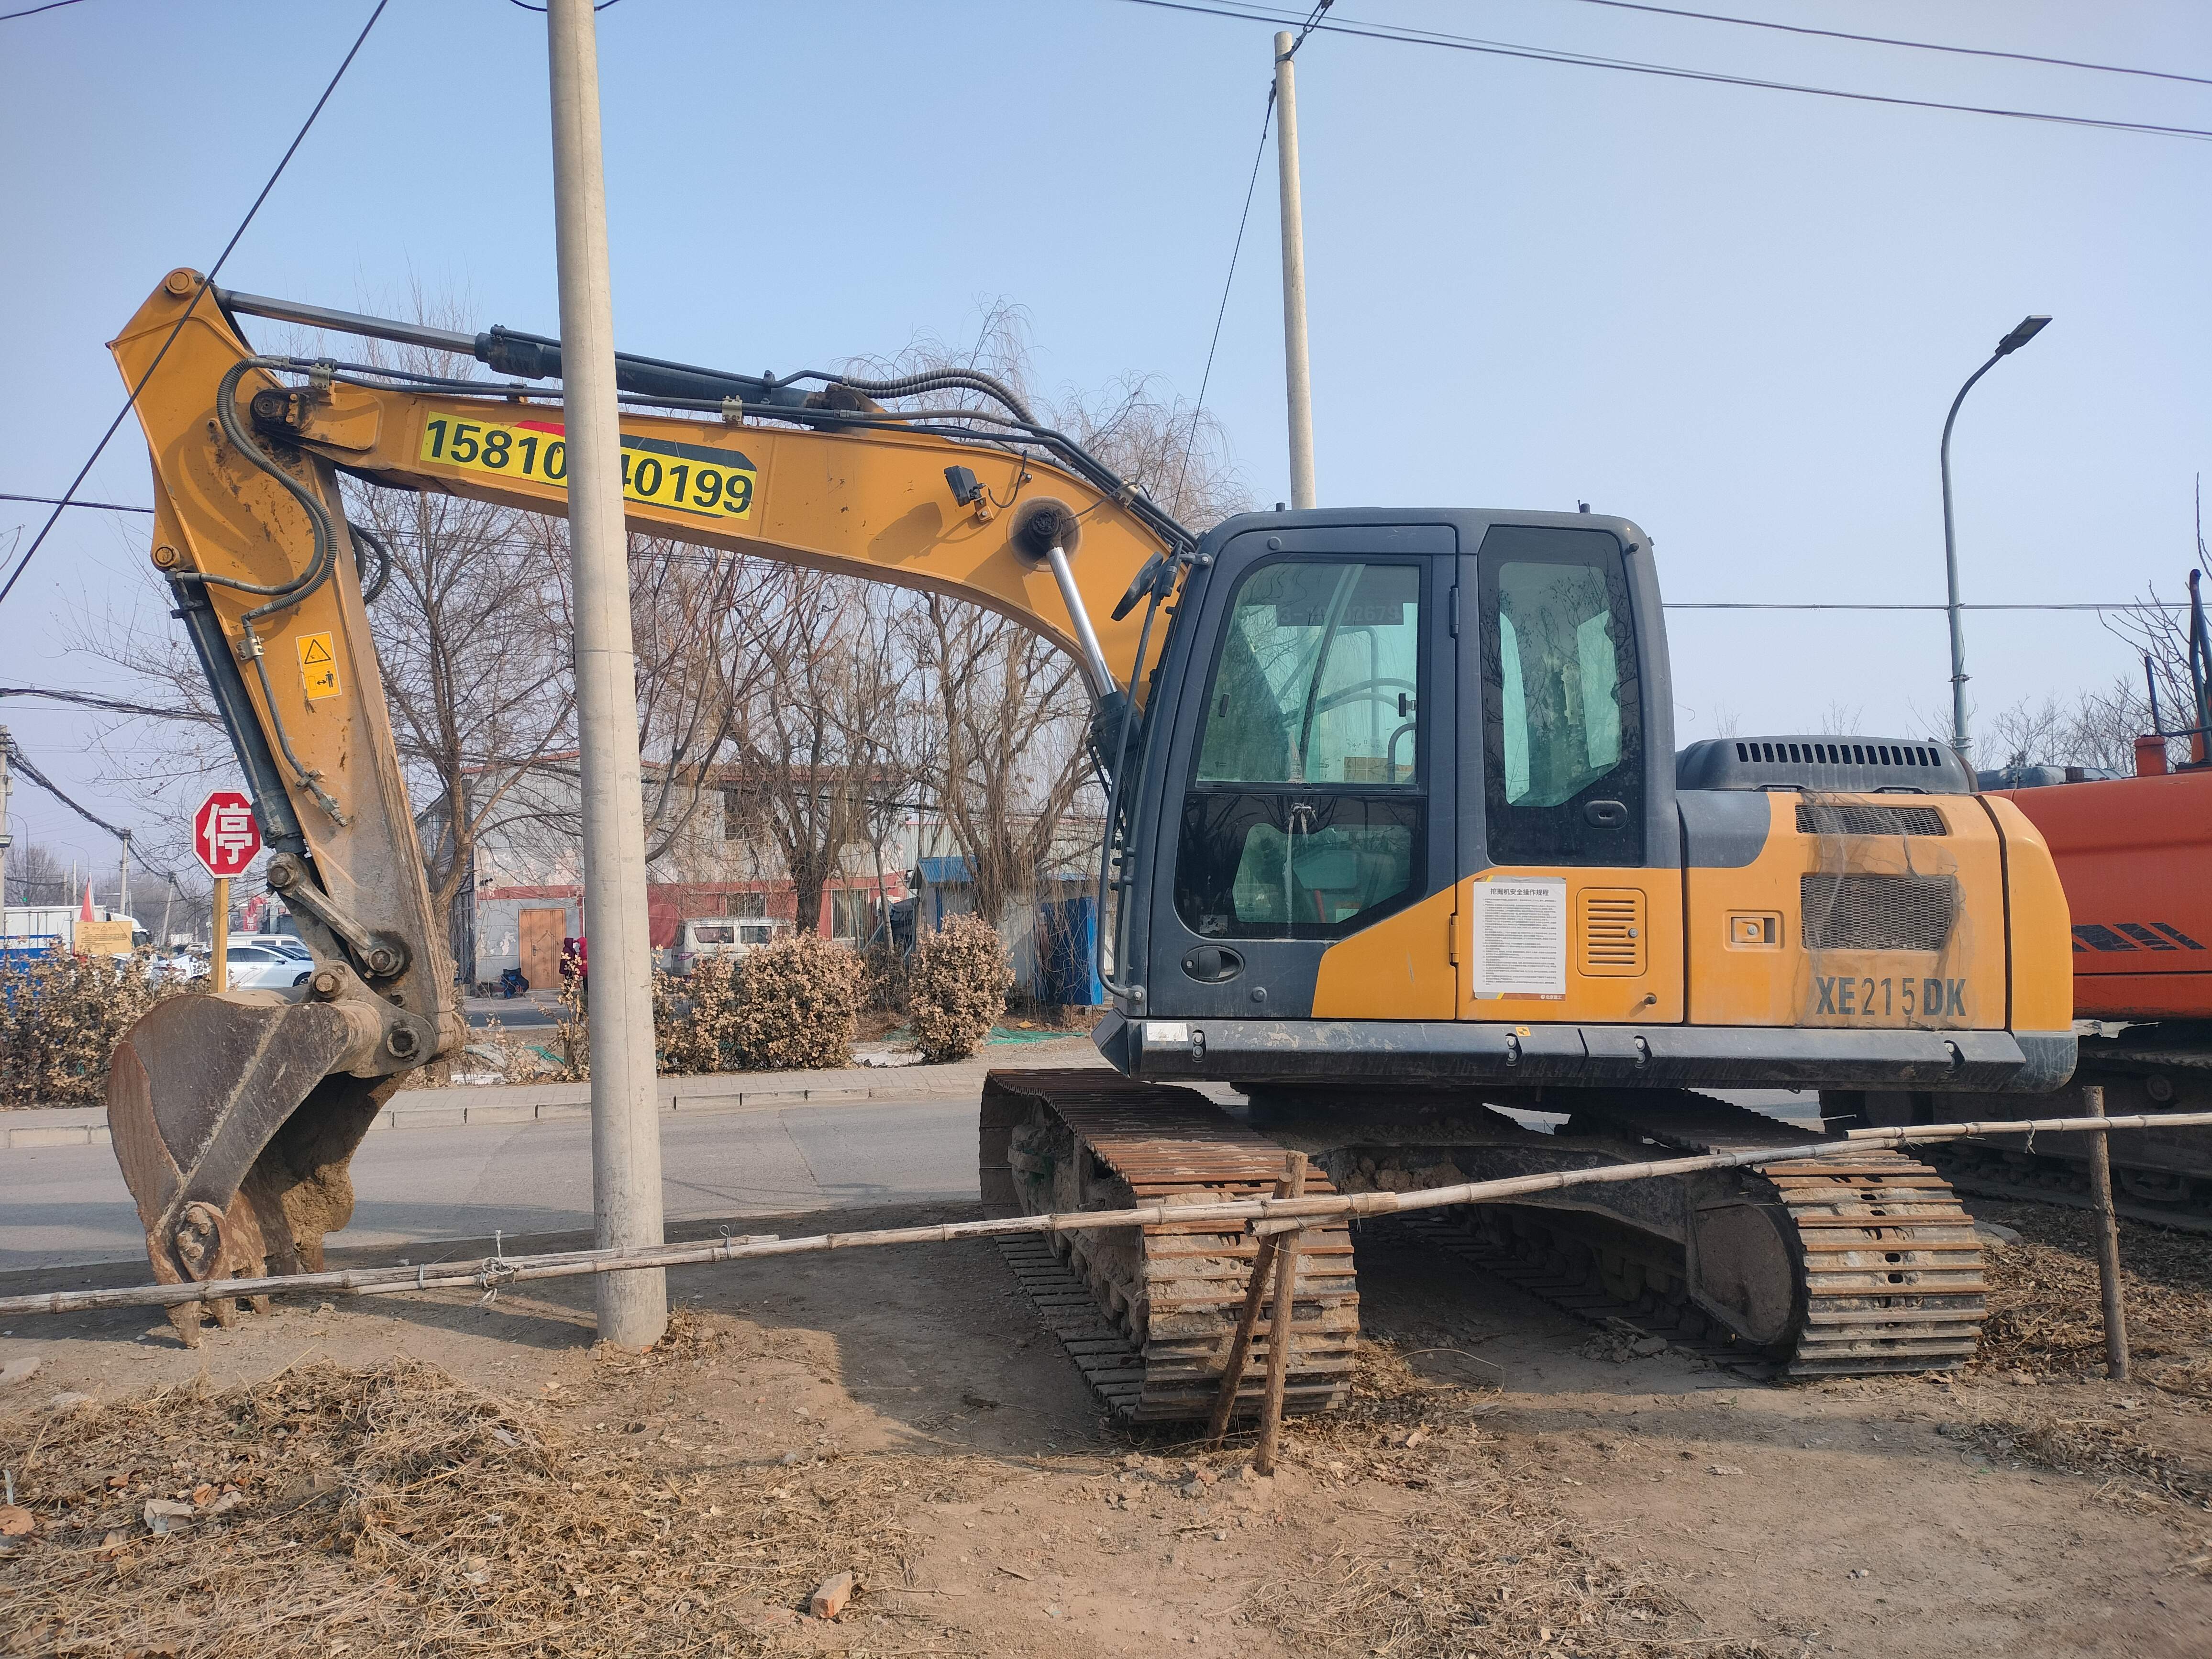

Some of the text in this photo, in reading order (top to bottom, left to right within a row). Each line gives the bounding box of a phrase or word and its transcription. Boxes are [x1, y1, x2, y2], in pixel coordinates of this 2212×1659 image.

[427, 420, 752, 513] 158100199
[202, 803, 253, 864] 停
[1490, 888, 1549, 896] 挖掘机安全操作规程
[1815, 977, 1967, 1017] XE215DK
